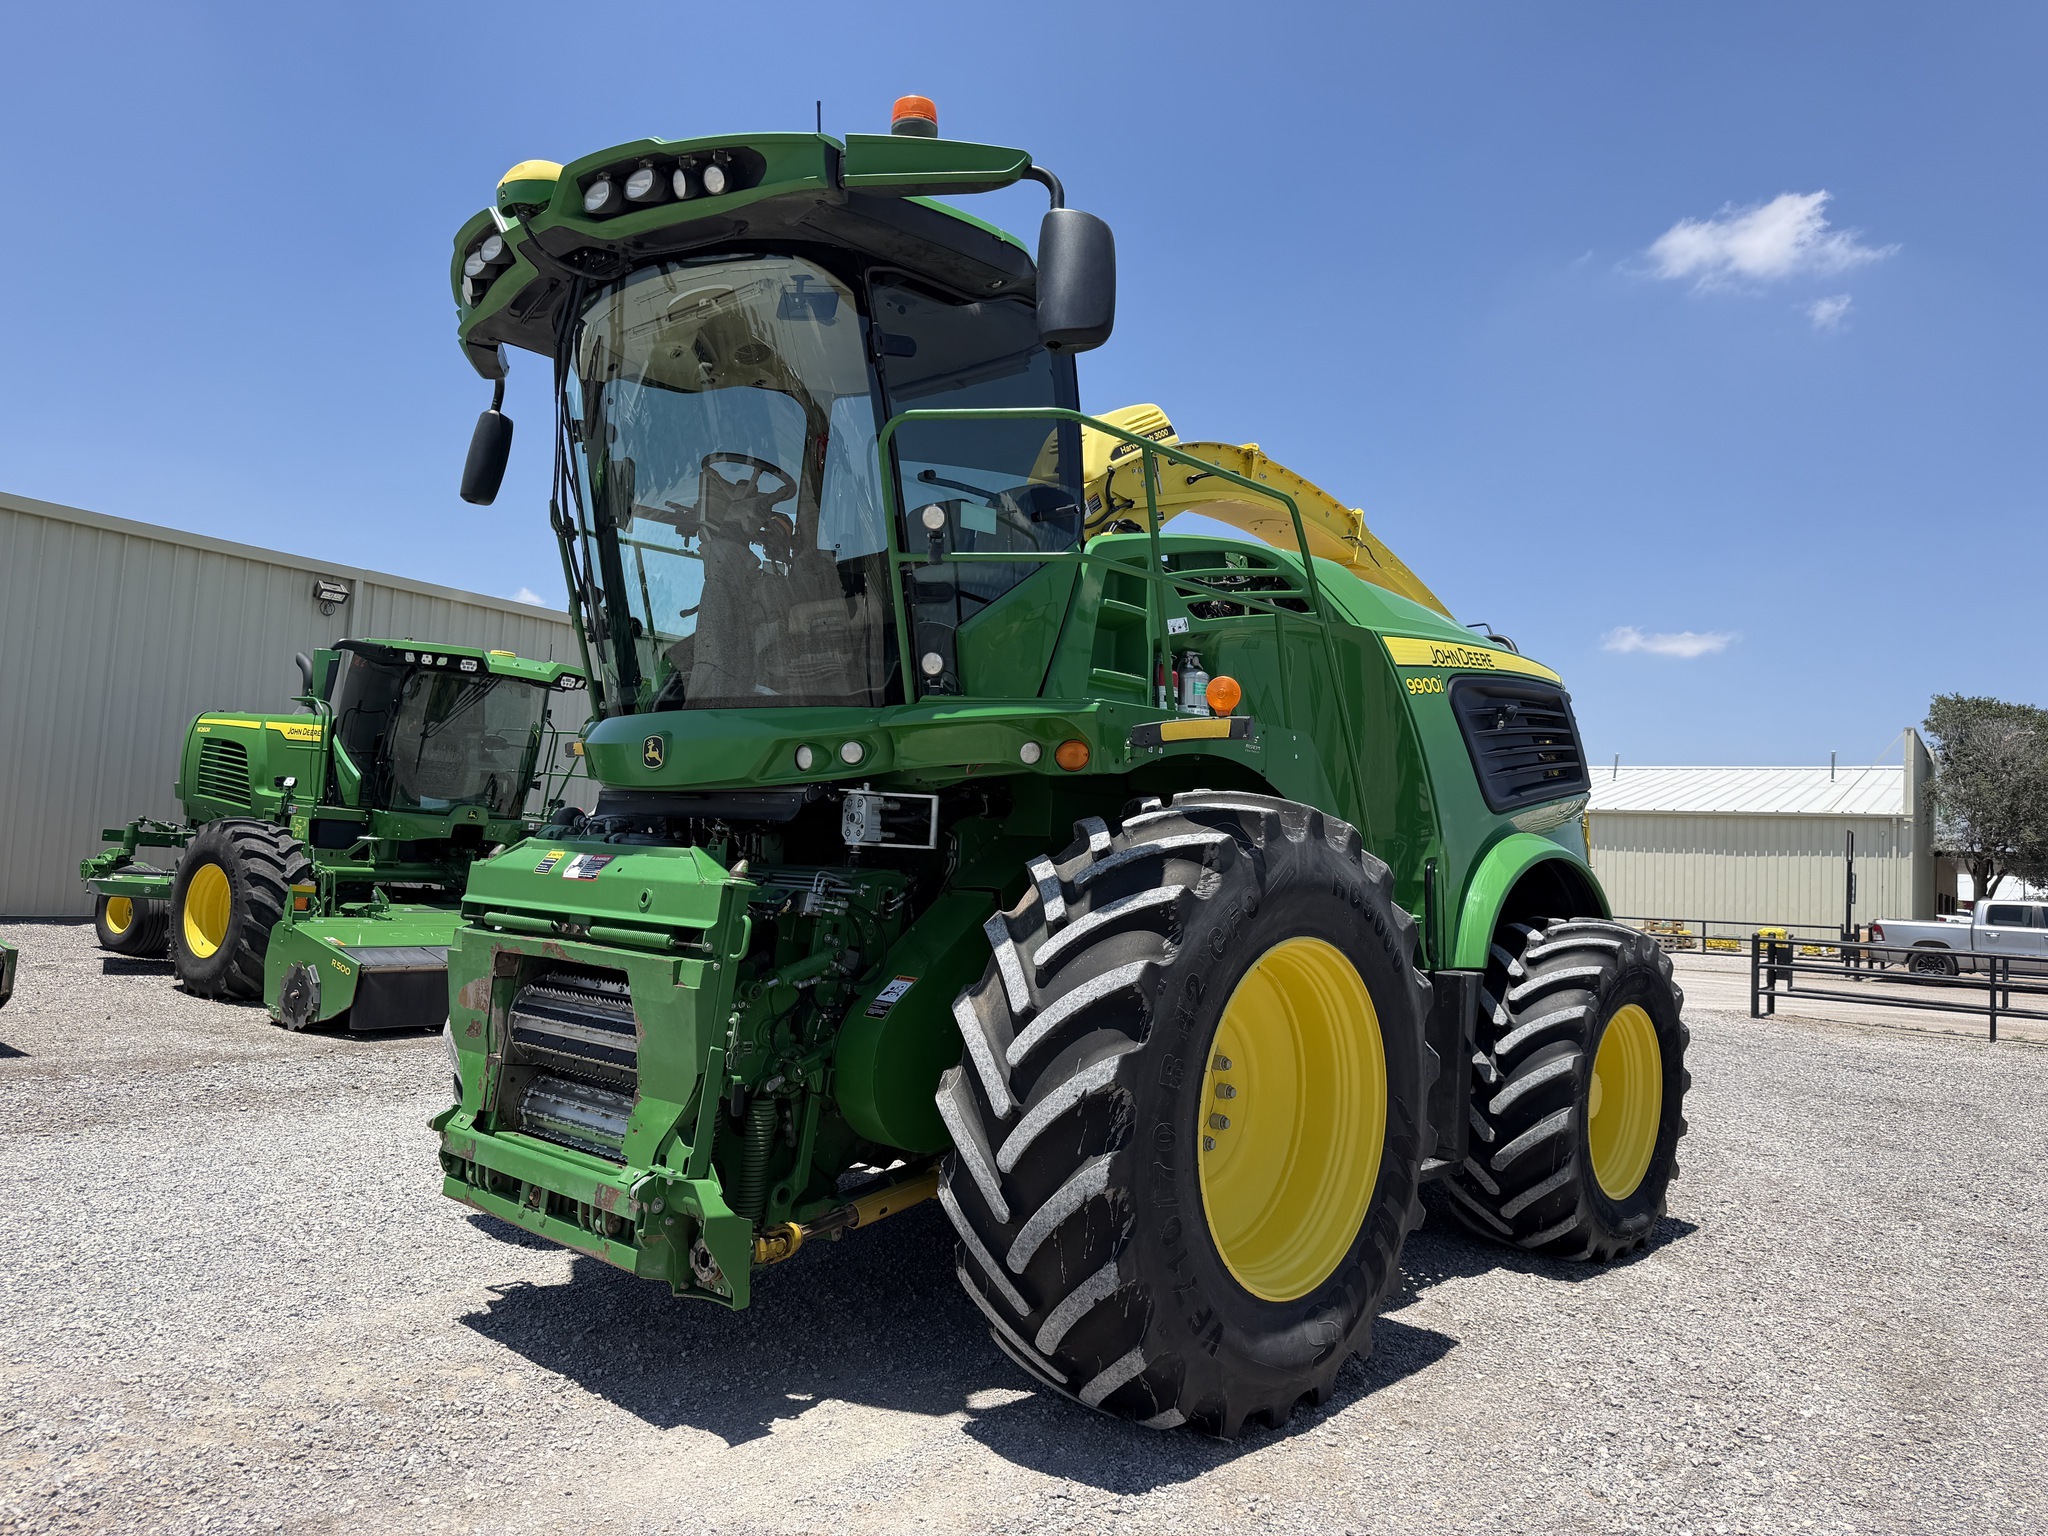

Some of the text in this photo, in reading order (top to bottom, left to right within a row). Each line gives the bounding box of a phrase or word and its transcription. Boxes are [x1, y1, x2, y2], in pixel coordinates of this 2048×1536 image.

[1154, 428, 1169, 440] 3000
[1429, 645, 1495, 668] JOHN DEERE
[1405, 674, 1445, 695] 9900i
[287, 727, 321, 737] JOHN DEERE
[331, 958, 351, 976] R500
